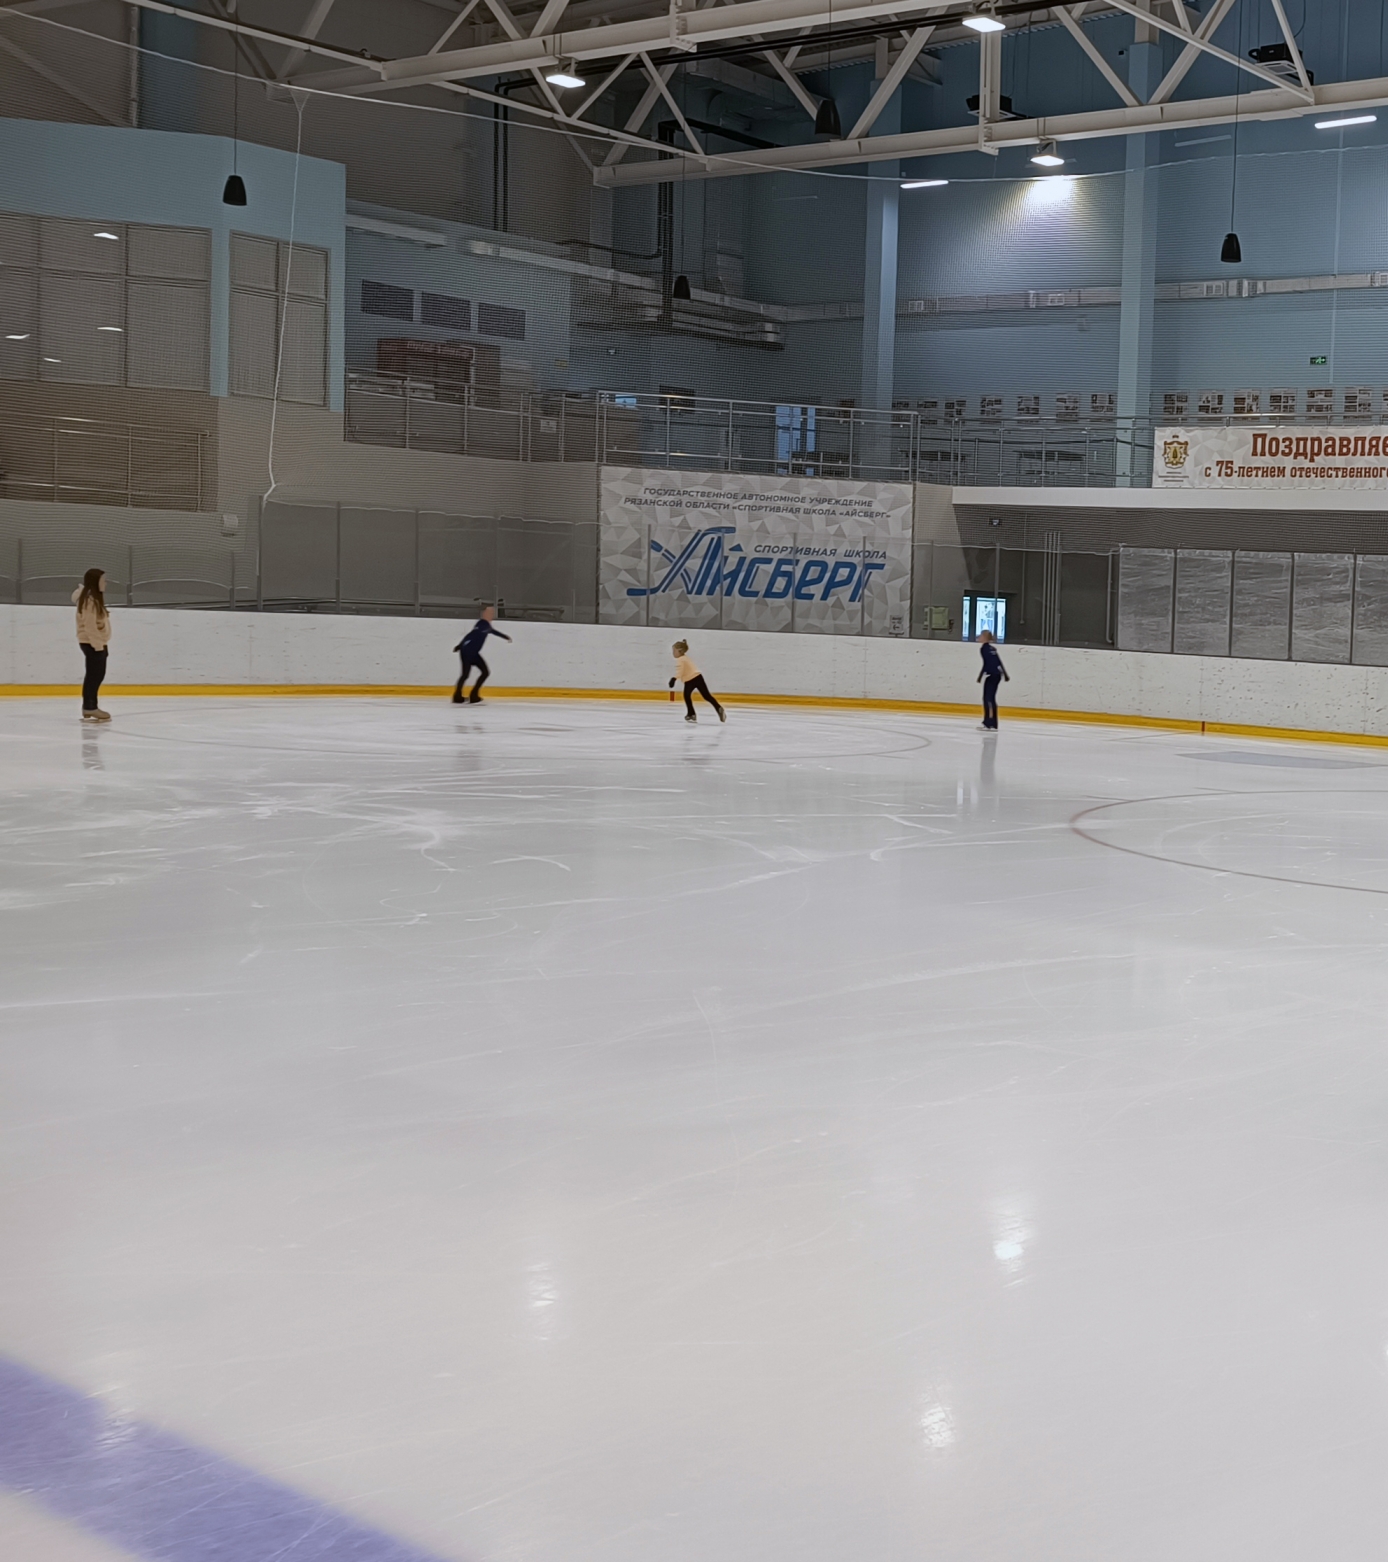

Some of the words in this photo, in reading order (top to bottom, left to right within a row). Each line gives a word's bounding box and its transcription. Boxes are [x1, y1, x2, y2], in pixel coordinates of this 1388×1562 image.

[1204, 466, 1212, 478] с
[1216, 460, 1286, 478] 75-летнем
[624, 497, 682, 508] РЯЗАНСКОЙ
[685, 501, 730, 510] ОБЛАСТИ
[803, 507, 837, 516] ШКОЛА
[644, 487, 739, 500] ГОСУДАРСТВЕННОЕ
[740, 493, 807, 504] АВТОНОМНОЕ
[809, 497, 873, 508] УЧРЕЖДЕНИЕ
[754, 544, 838, 557] СПОРТИВНАЯ
[843, 549, 887, 560] ШКОЛА
